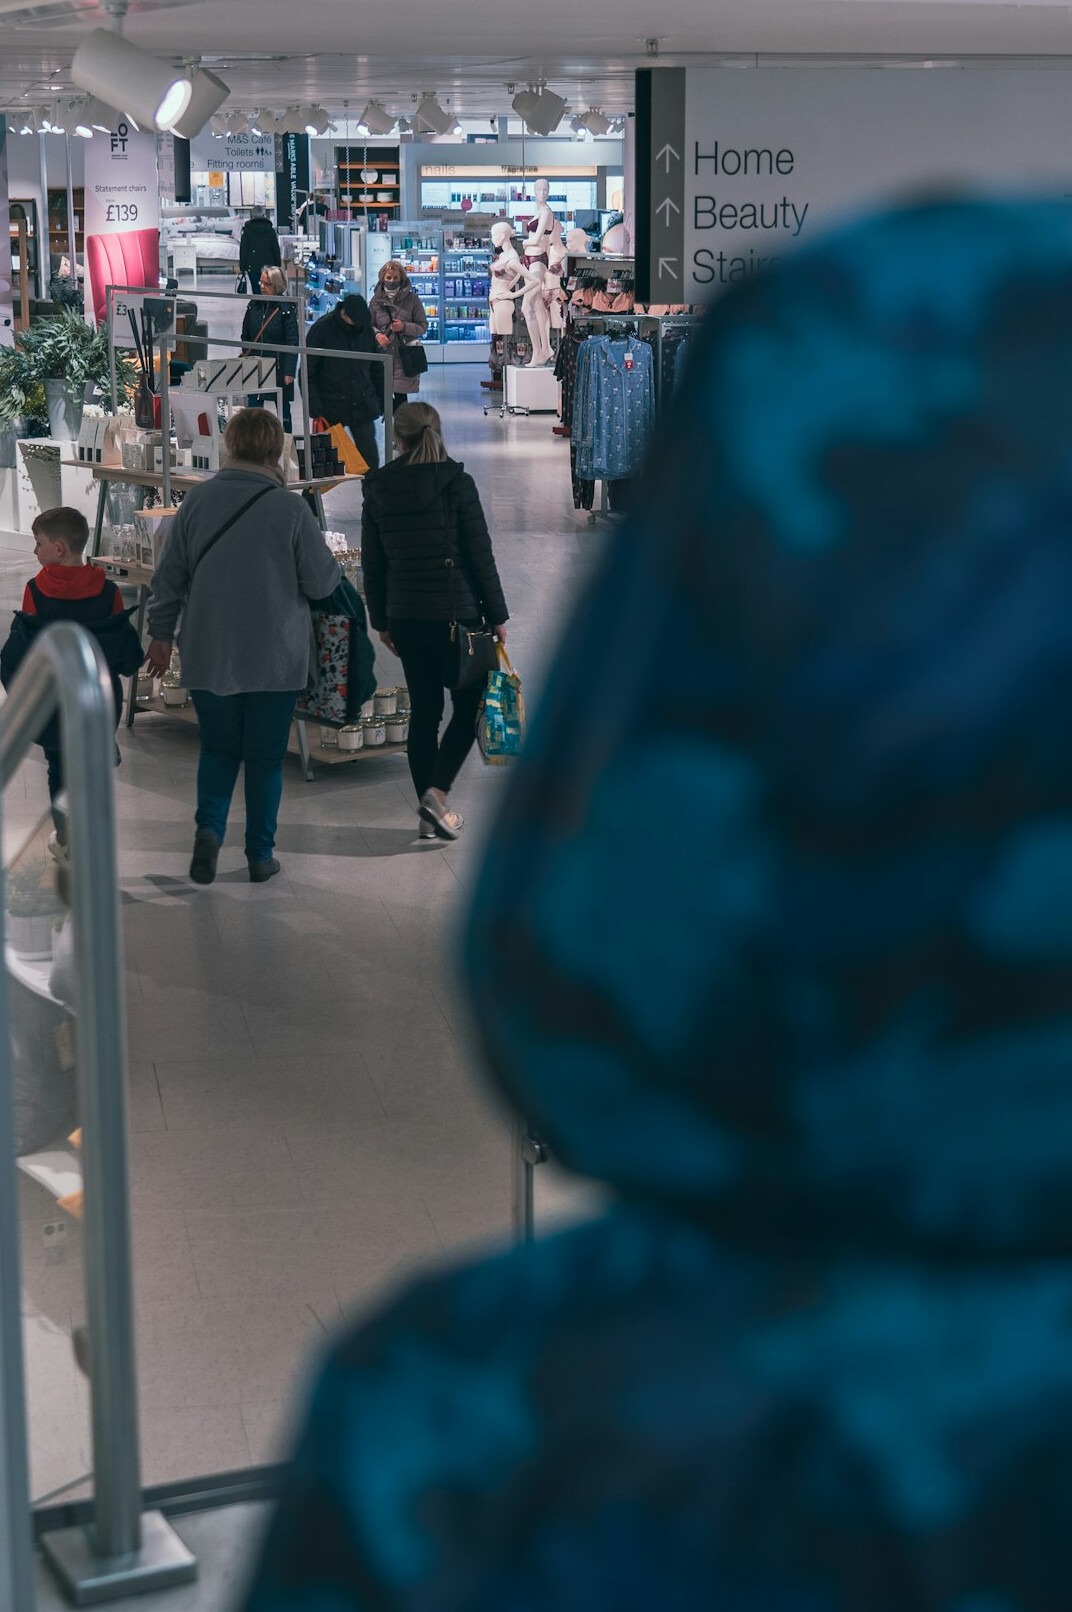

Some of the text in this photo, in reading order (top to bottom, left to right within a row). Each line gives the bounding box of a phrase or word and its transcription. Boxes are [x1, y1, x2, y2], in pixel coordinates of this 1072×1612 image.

[227, 134, 272, 144] M&S Café
[111, 138, 128, 152] FT
[225, 147, 254, 157] Toilets
[695, 141, 794, 175] Home
[207, 159, 265, 170] Fitting rooms
[425, 164, 456, 175] nails
[128, 184, 147, 192] chairs
[106, 204, 138, 221] £139
[695, 196, 809, 237] Beauty
[116, 304, 127, 316] £3
